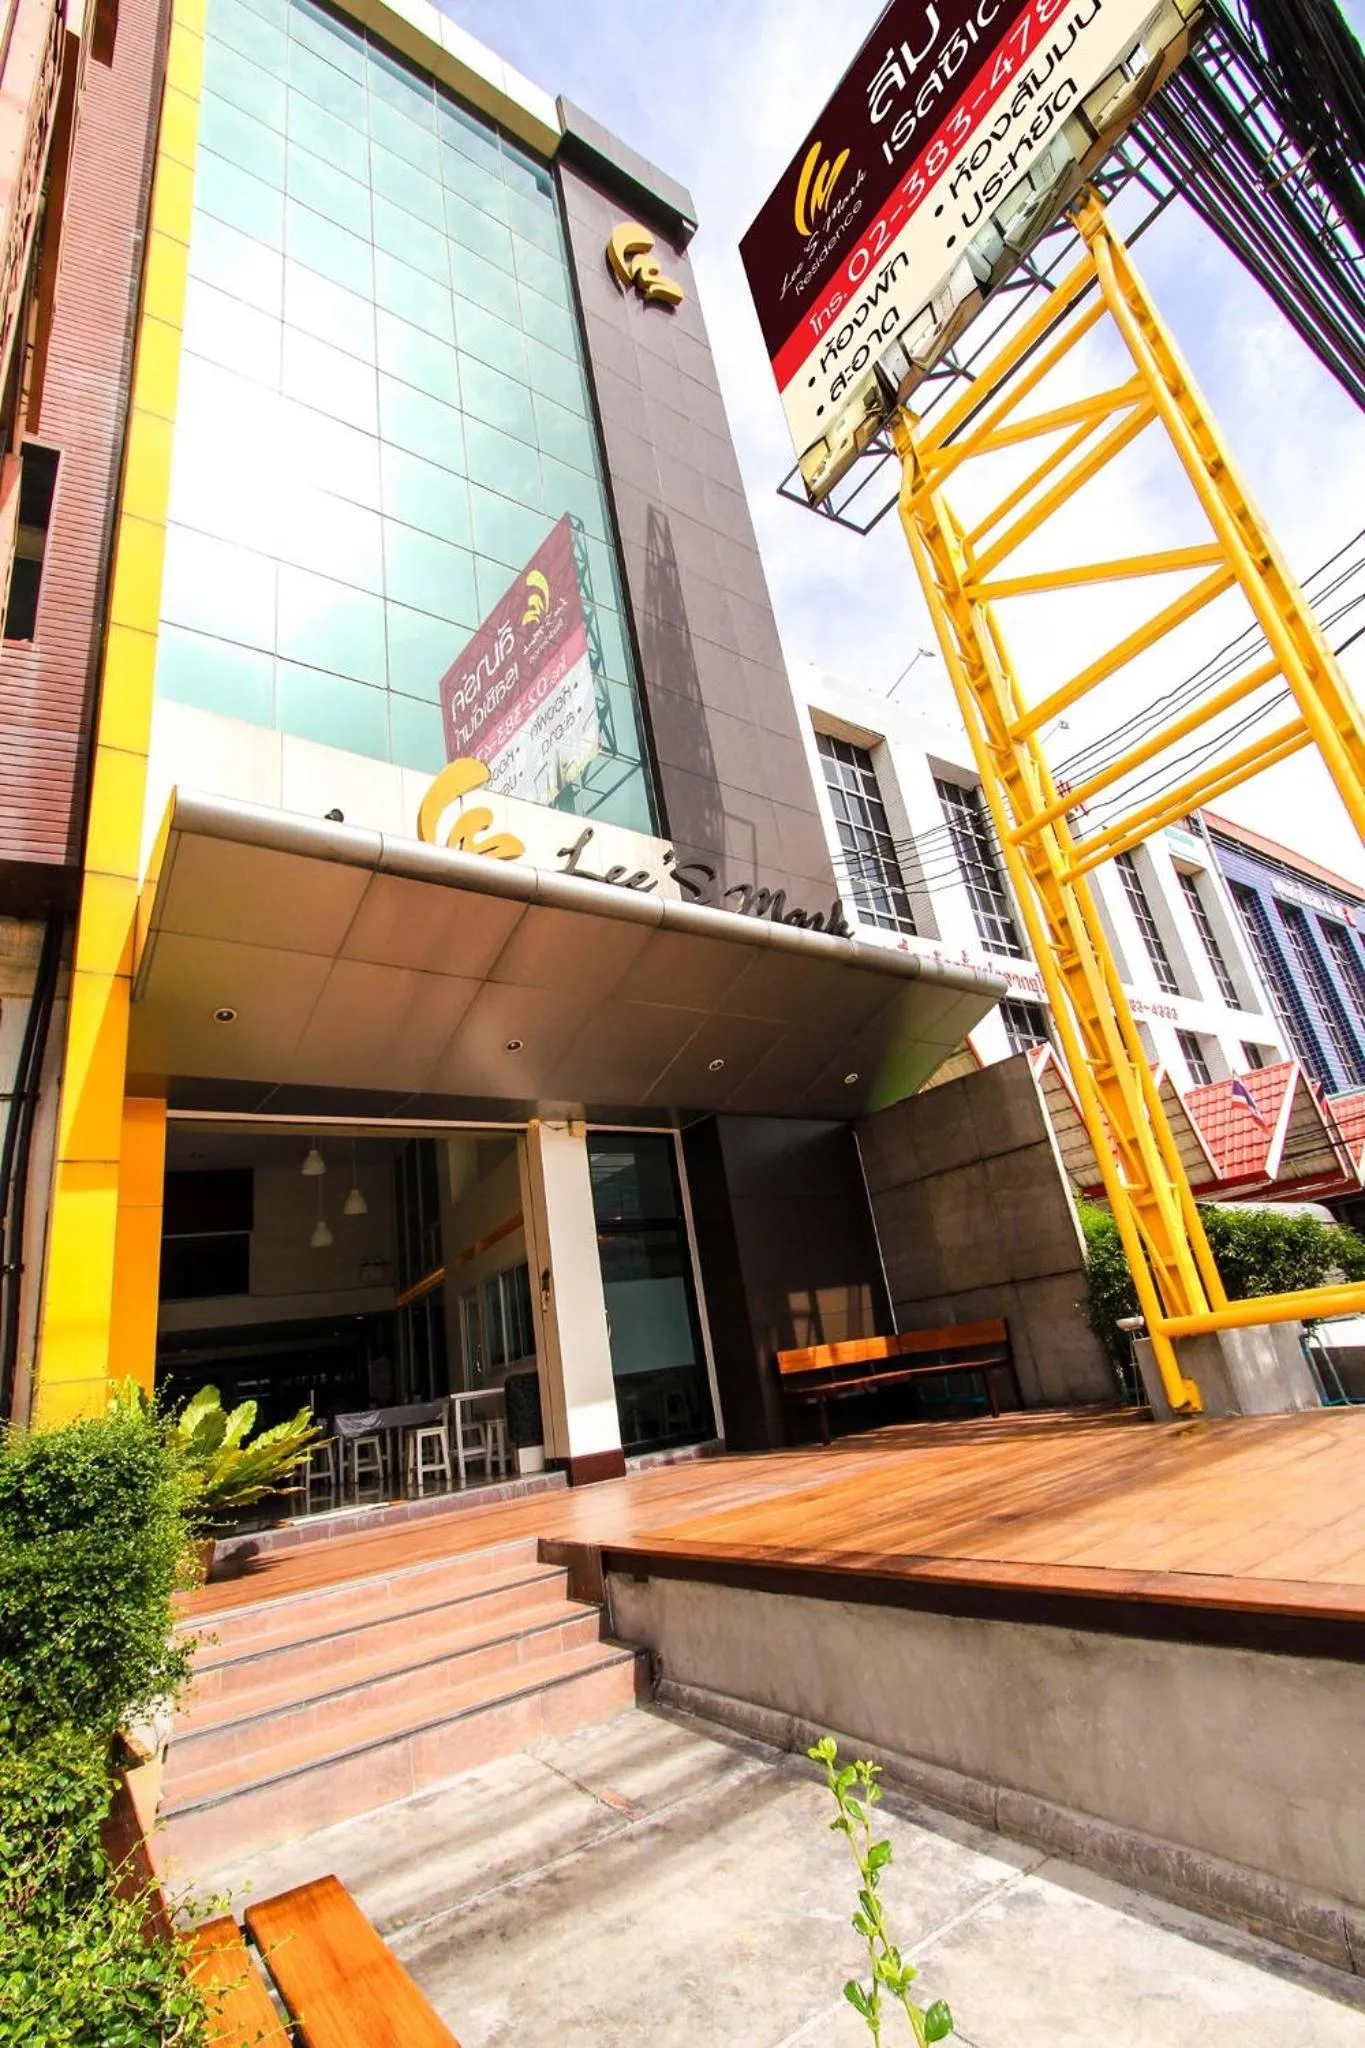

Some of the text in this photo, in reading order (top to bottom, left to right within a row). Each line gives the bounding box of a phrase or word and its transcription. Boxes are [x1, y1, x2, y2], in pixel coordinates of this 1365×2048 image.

[960, 77, 1079, 228] ประหยัด
[795, 200, 863, 296] Residence
[819, 251, 909, 374] ห้องพัก
[829, 305, 901, 402] สะอาด
